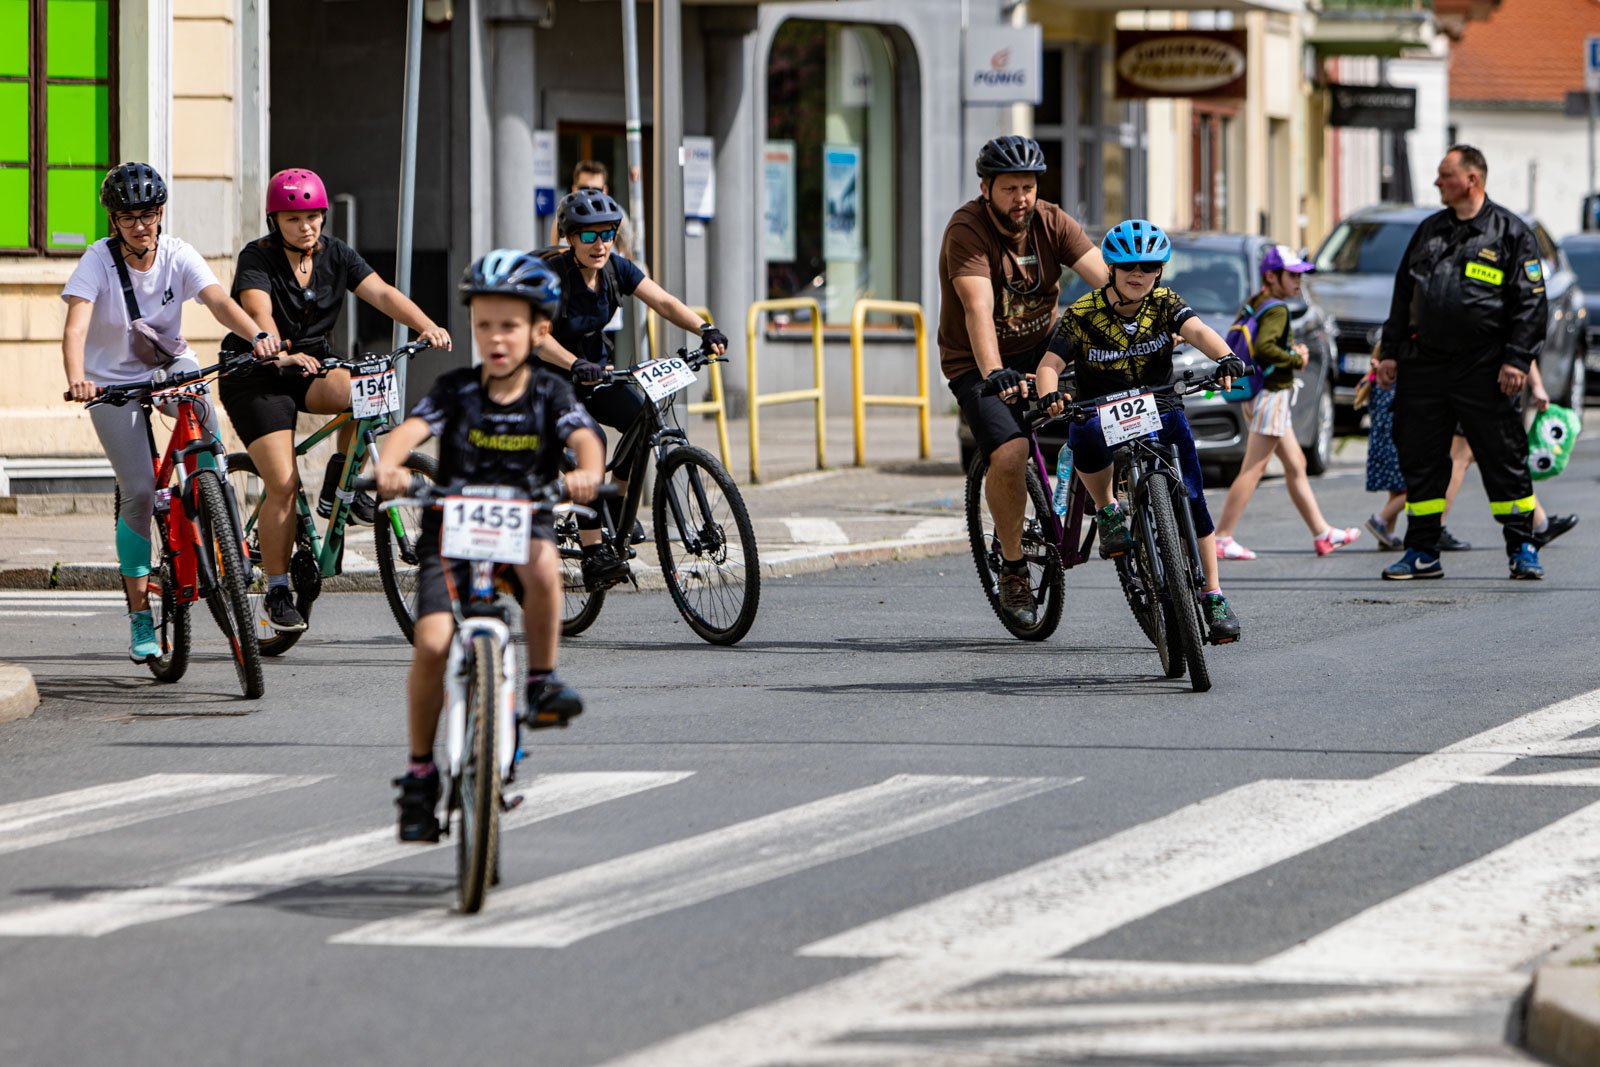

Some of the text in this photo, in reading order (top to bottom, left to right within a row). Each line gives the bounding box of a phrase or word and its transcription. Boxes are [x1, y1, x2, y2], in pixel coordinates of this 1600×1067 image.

[1088, 331, 1171, 362] RUNMAGEDDON
[641, 359, 682, 383] 1456
[356, 373, 394, 397] 1547
[1109, 398, 1147, 421] 192
[453, 503, 522, 530] 1455
